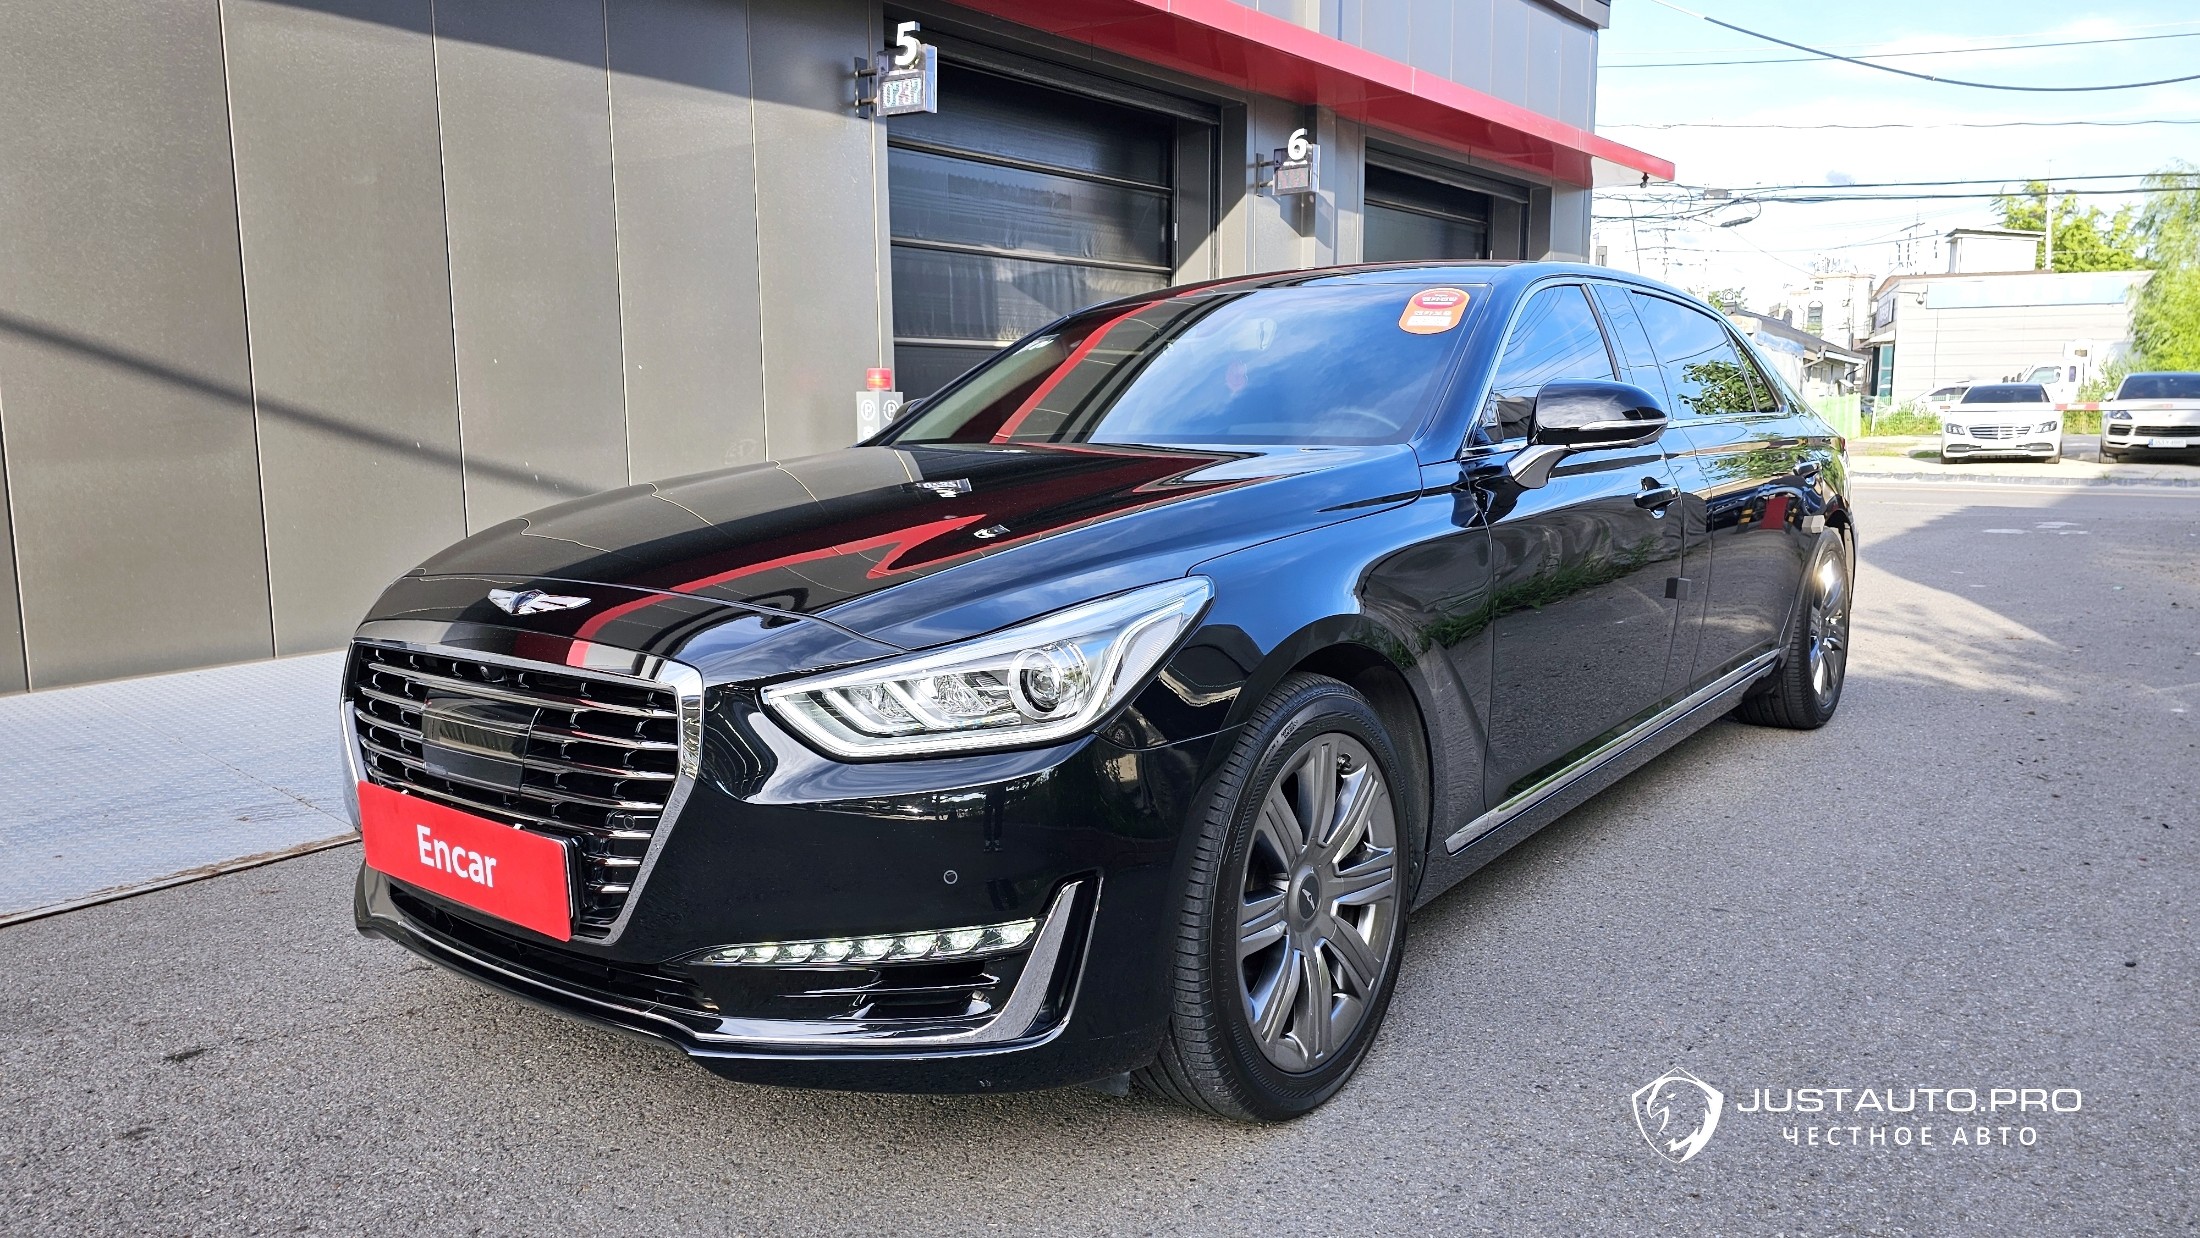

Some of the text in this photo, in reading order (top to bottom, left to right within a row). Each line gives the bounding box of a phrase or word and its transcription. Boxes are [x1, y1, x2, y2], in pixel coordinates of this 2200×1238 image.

[894, 21, 921, 68] 5
[1287, 128, 1309, 161] 6
[416, 824, 497, 888] Encar
